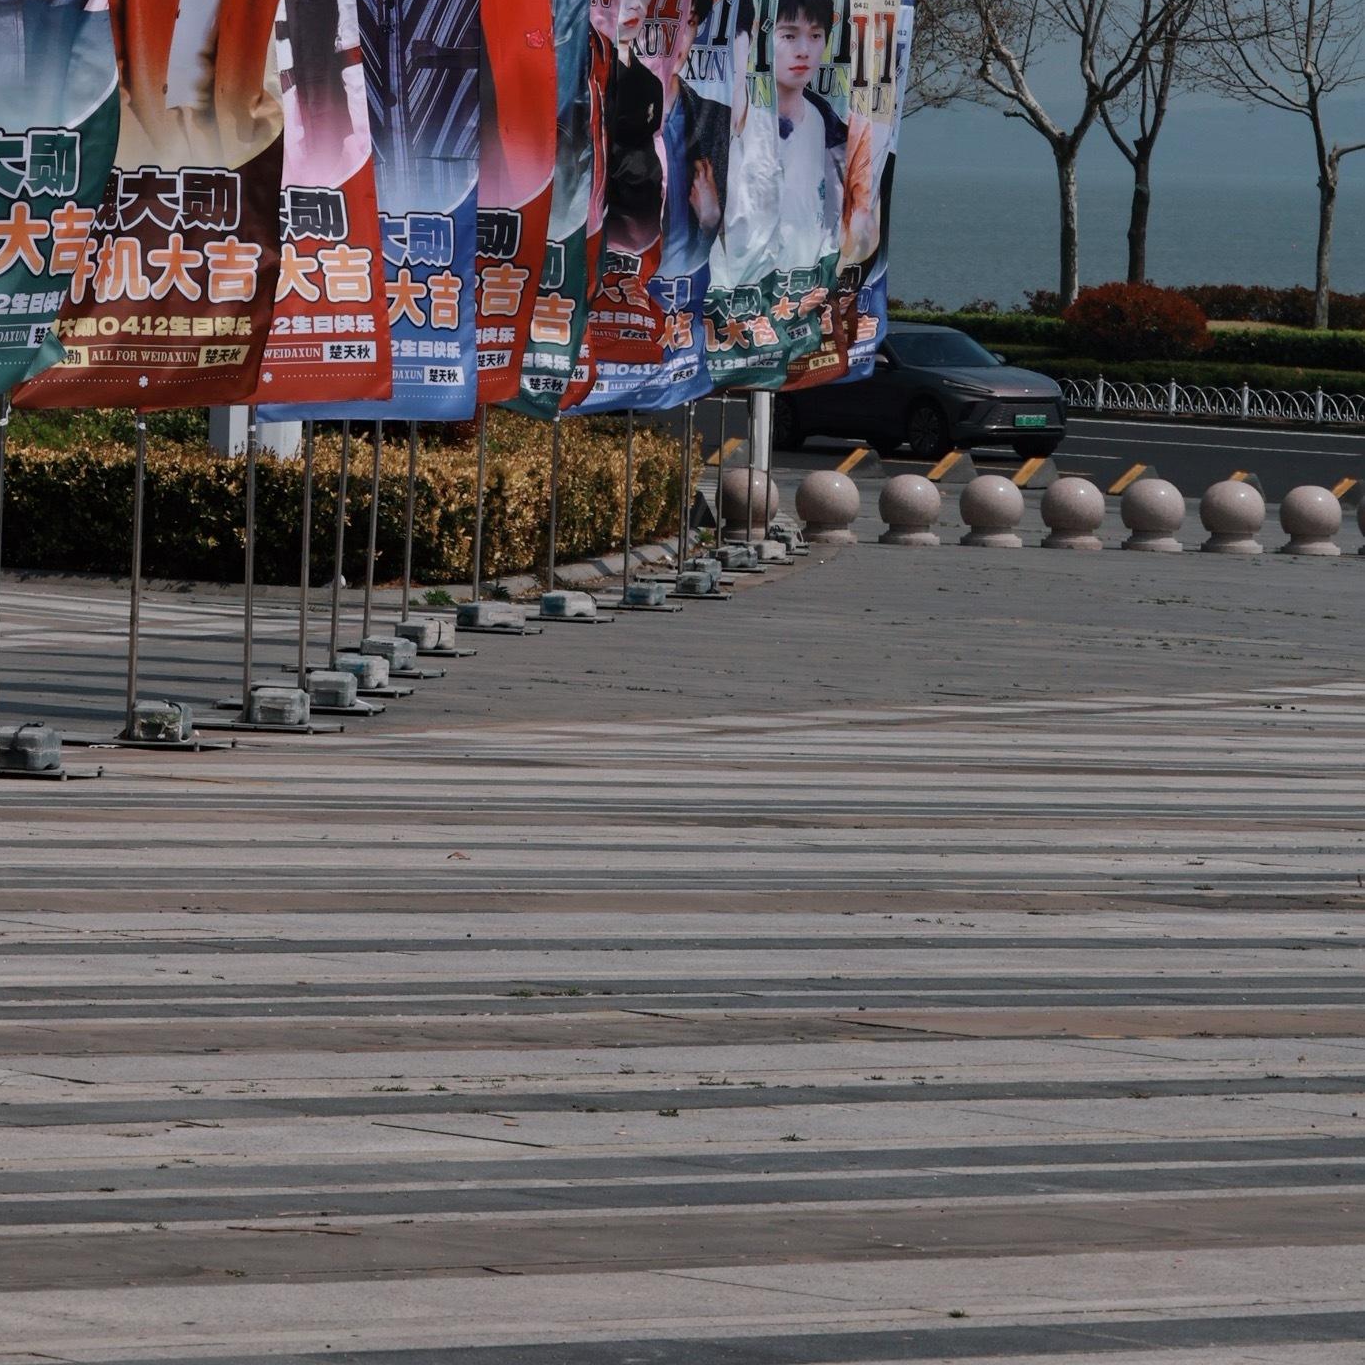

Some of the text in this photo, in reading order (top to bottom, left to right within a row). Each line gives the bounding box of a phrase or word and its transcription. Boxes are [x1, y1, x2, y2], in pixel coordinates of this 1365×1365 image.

[268, 315, 376, 336] 2生日快乐
[91, 350, 198, 363] ALL FOR WEIDAXUN
[204, 347, 242, 364] 楚天秋
[329, 344, 371, 360] 楚天秋
[428, 368, 458, 383] 楚天秋
[529, 377, 564, 393] 楚天秋
